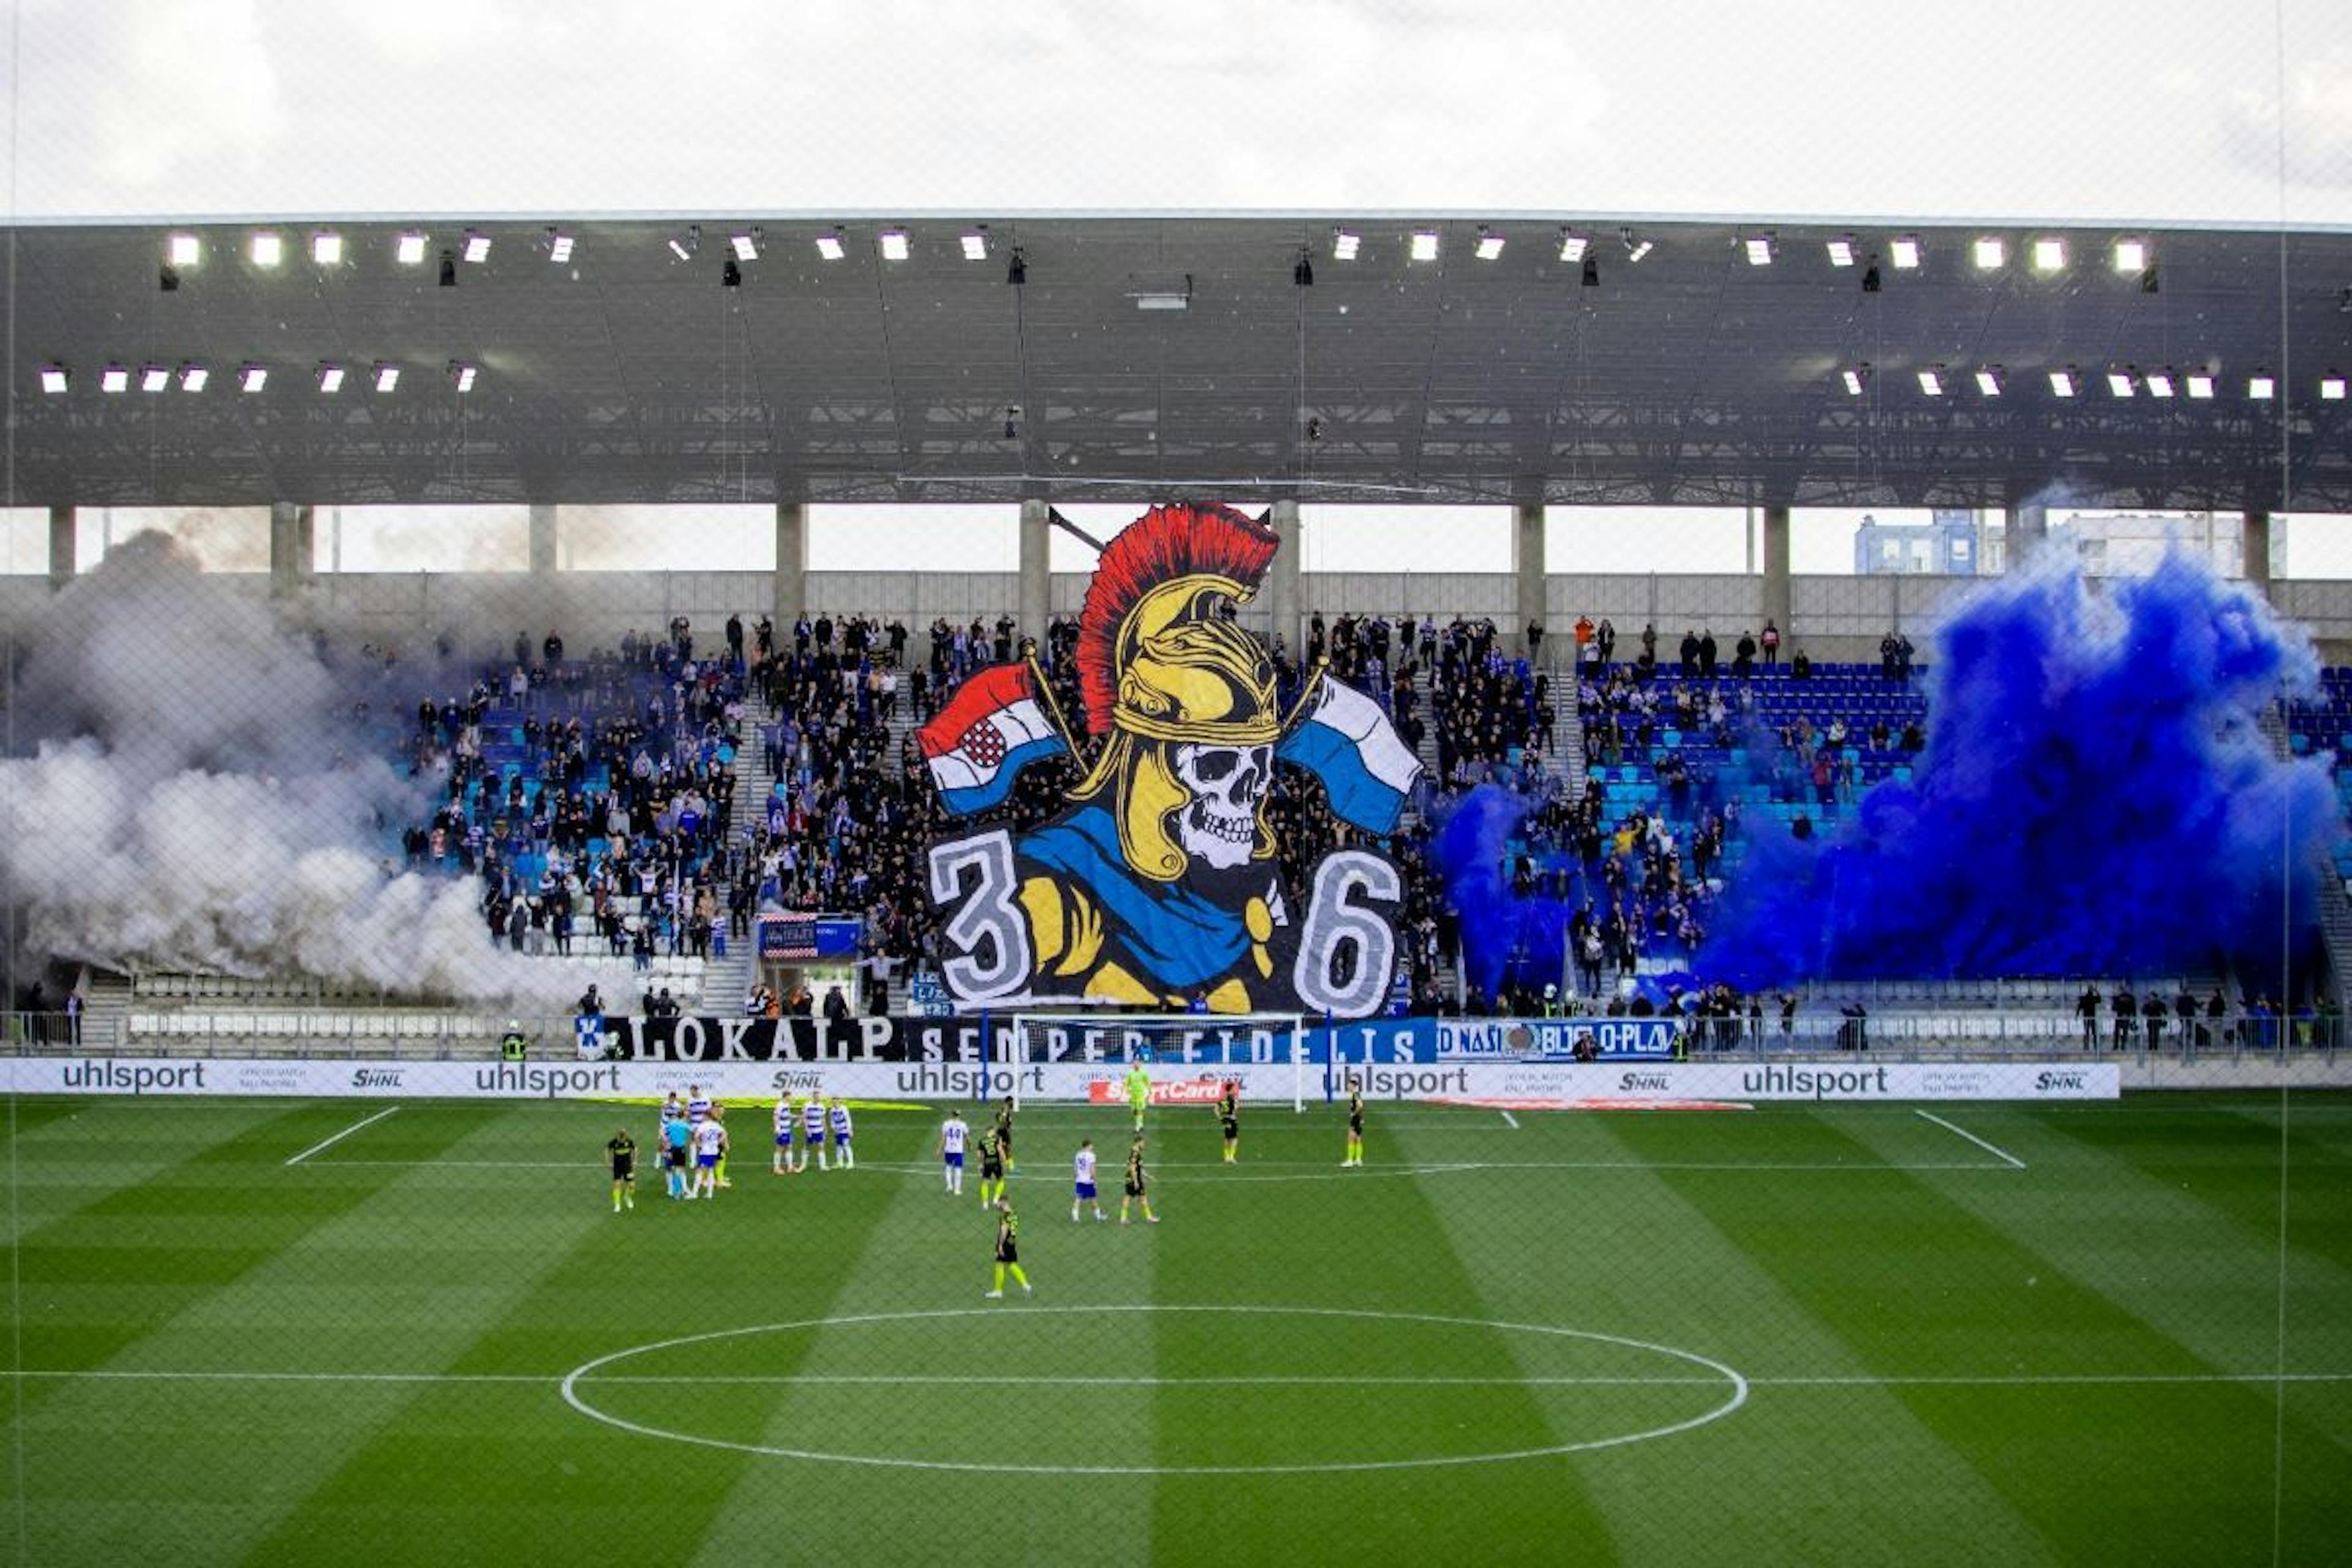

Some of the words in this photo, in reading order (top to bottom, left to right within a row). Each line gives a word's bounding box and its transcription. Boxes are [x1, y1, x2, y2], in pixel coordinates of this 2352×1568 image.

[929, 830, 1031, 1000] 3
[1294, 850, 1401, 1018] 6
[628, 1016, 893, 1061] LOKALP
[1183, 1028, 1414, 1064] FIDELIS
[64, 1060, 204, 1093] uhlsport
[477, 1063, 620, 1095] uhlsport
[897, 1064, 1044, 1099] uhlsport
[1323, 1066, 1468, 1100] uhlsport
[1744, 1065, 1888, 1099] uhlsport
